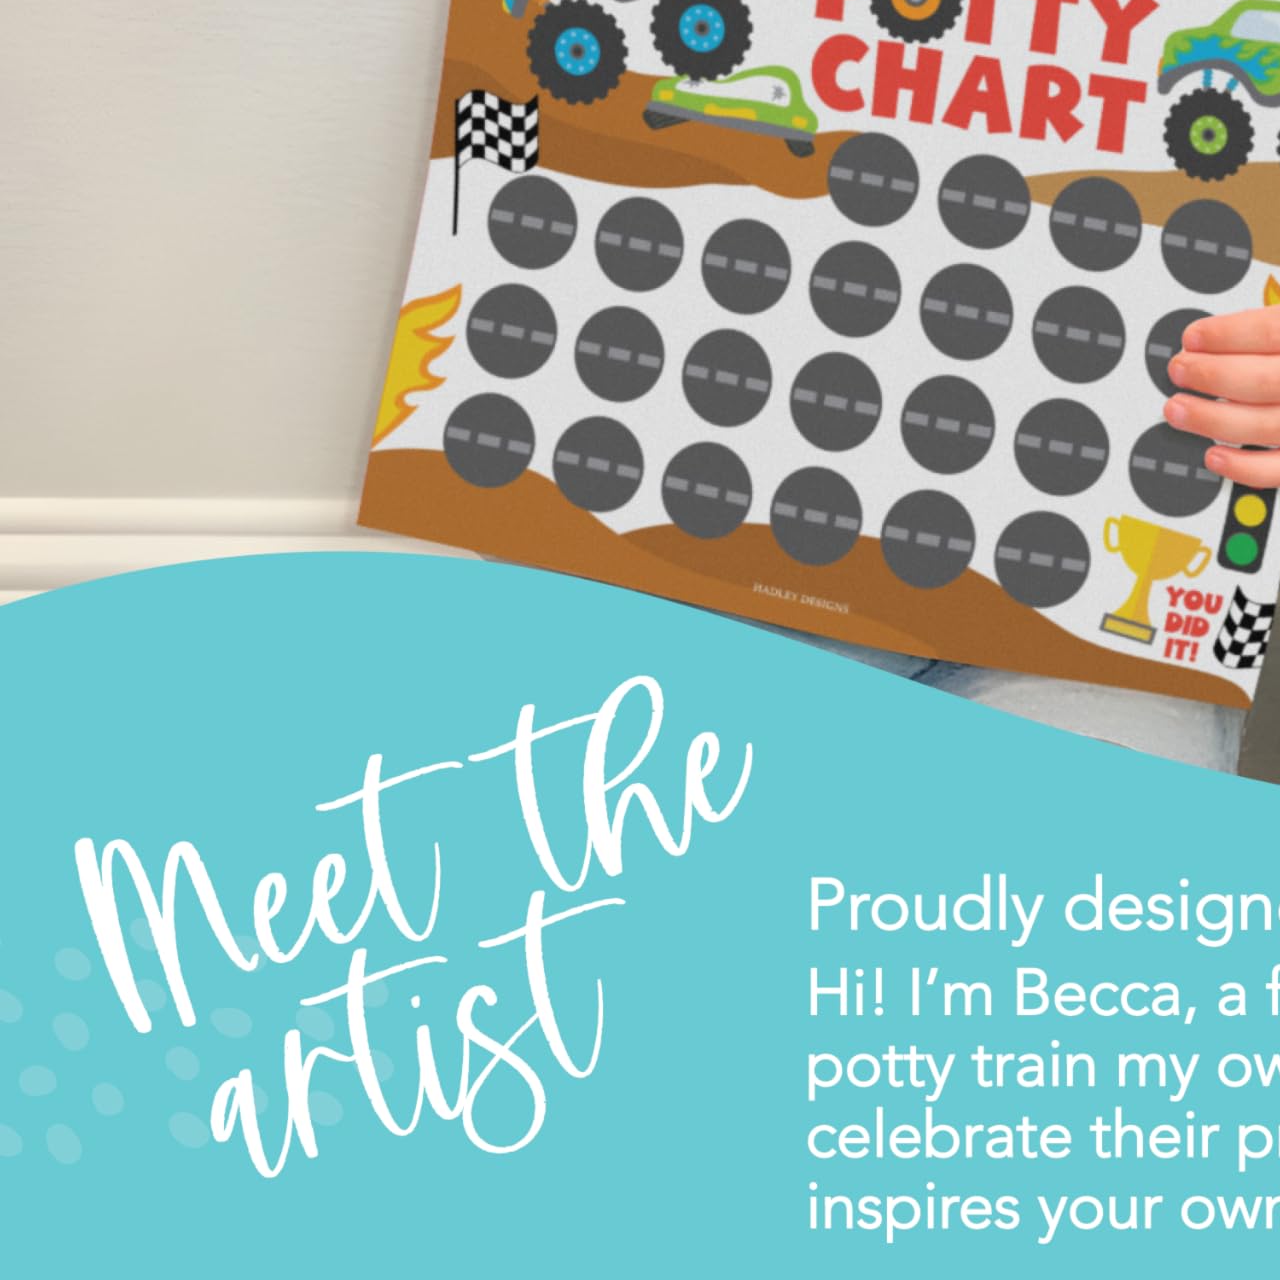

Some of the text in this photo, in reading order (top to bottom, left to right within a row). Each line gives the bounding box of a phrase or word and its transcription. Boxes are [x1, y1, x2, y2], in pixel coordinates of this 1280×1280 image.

[811, 34, 1148, 154] CHART
[753, 581, 798, 601] HADLEY
[1166, 585, 1223, 615] YOU
[1164, 611, 1210, 638] DID
[1164, 637, 1199, 663] IT!
